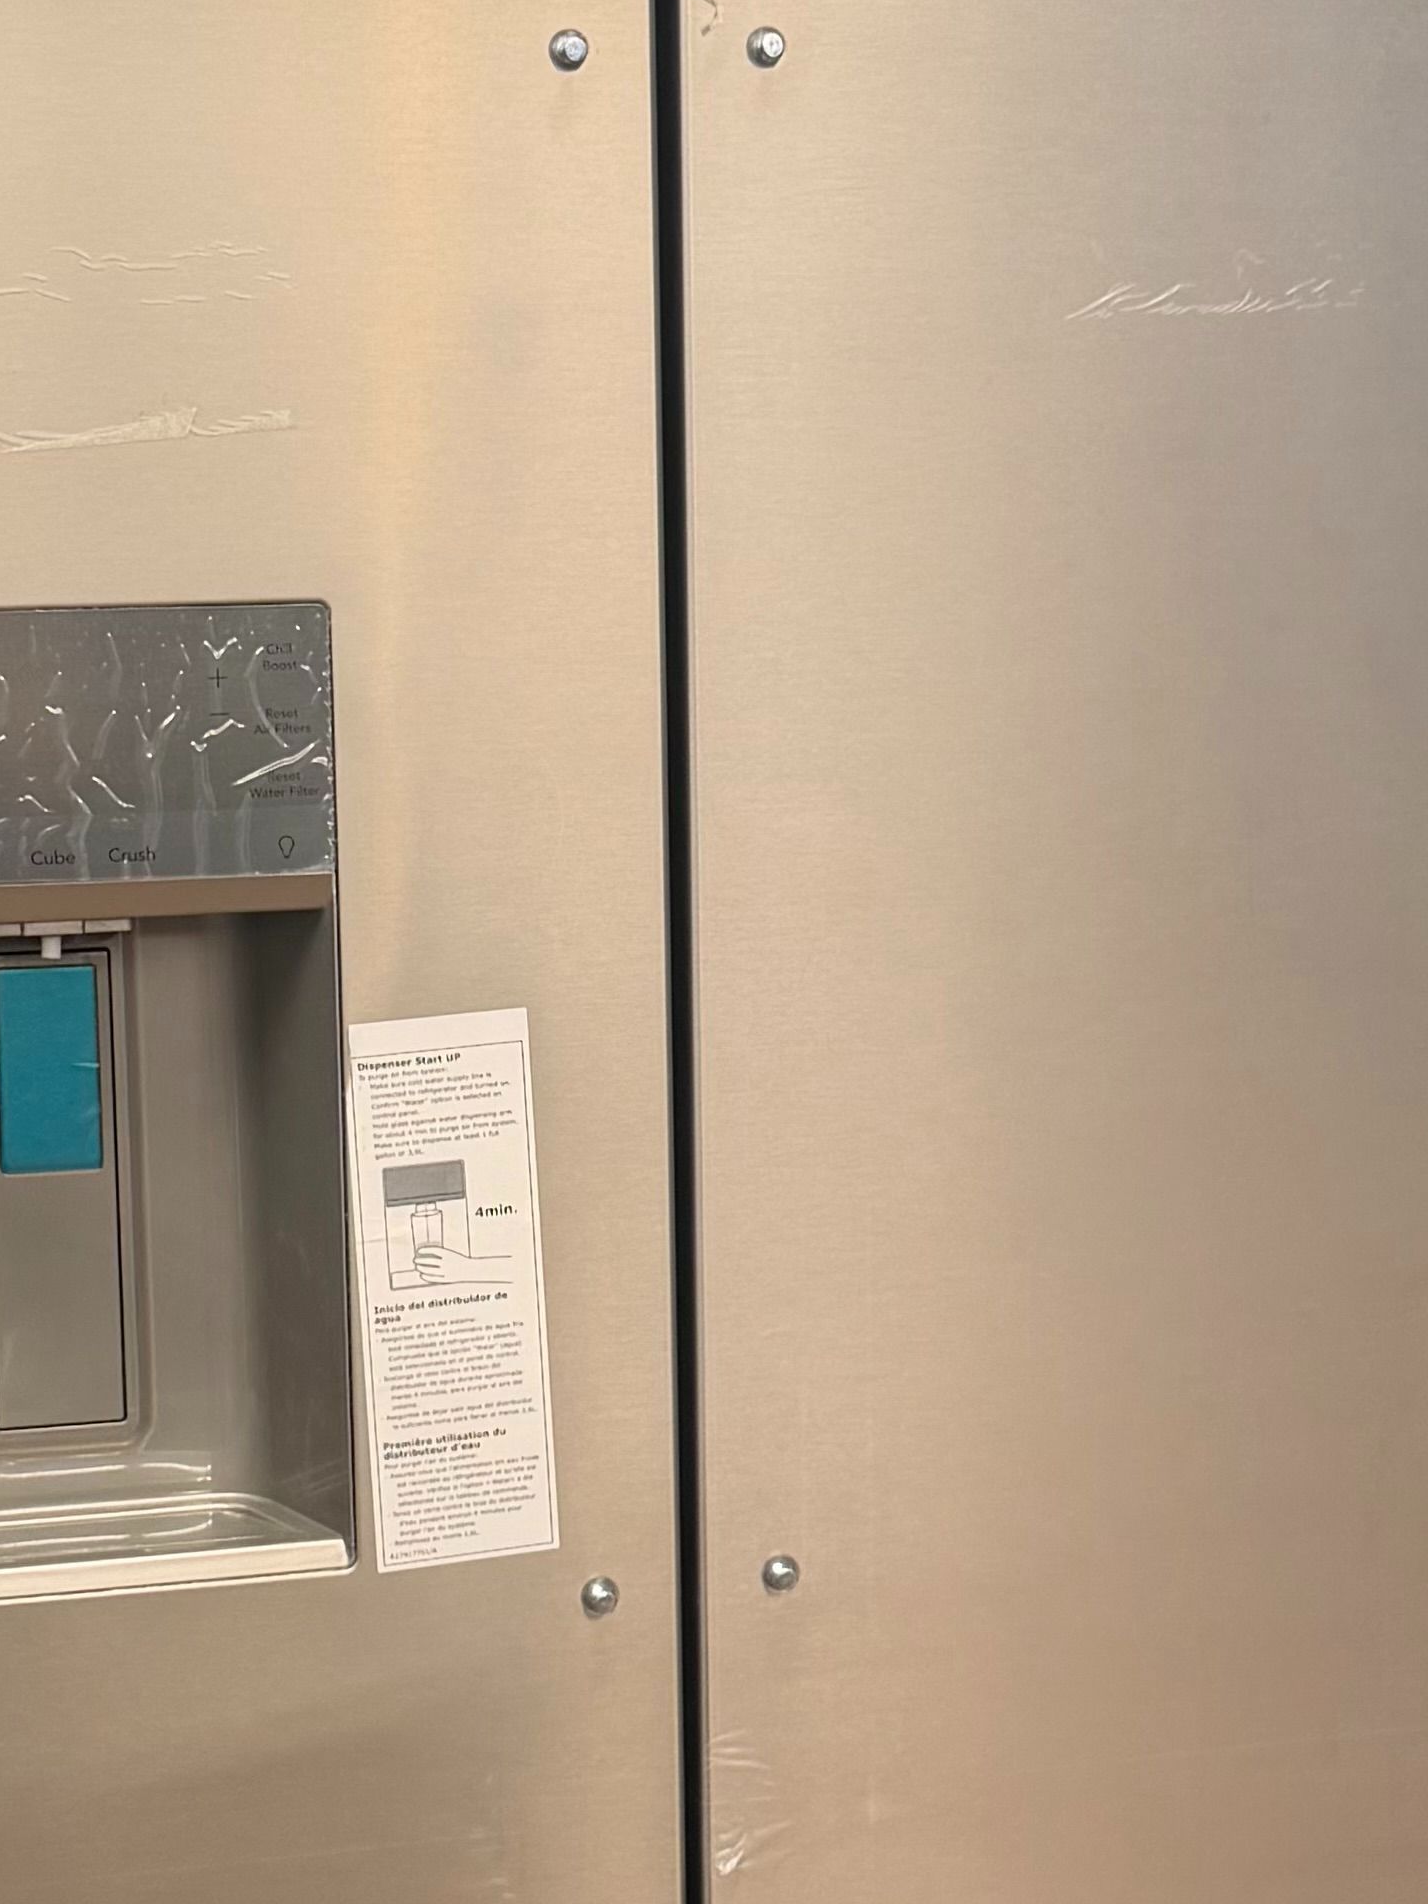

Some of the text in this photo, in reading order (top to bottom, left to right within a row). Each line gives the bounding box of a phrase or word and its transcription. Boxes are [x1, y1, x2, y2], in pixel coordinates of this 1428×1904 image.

[31, 849, 76, 866] Cube
[108, 846, 156, 863] Crush
[357, 1058, 412, 1072] Dispenser
[415, 1054, 442, 1066] Start
